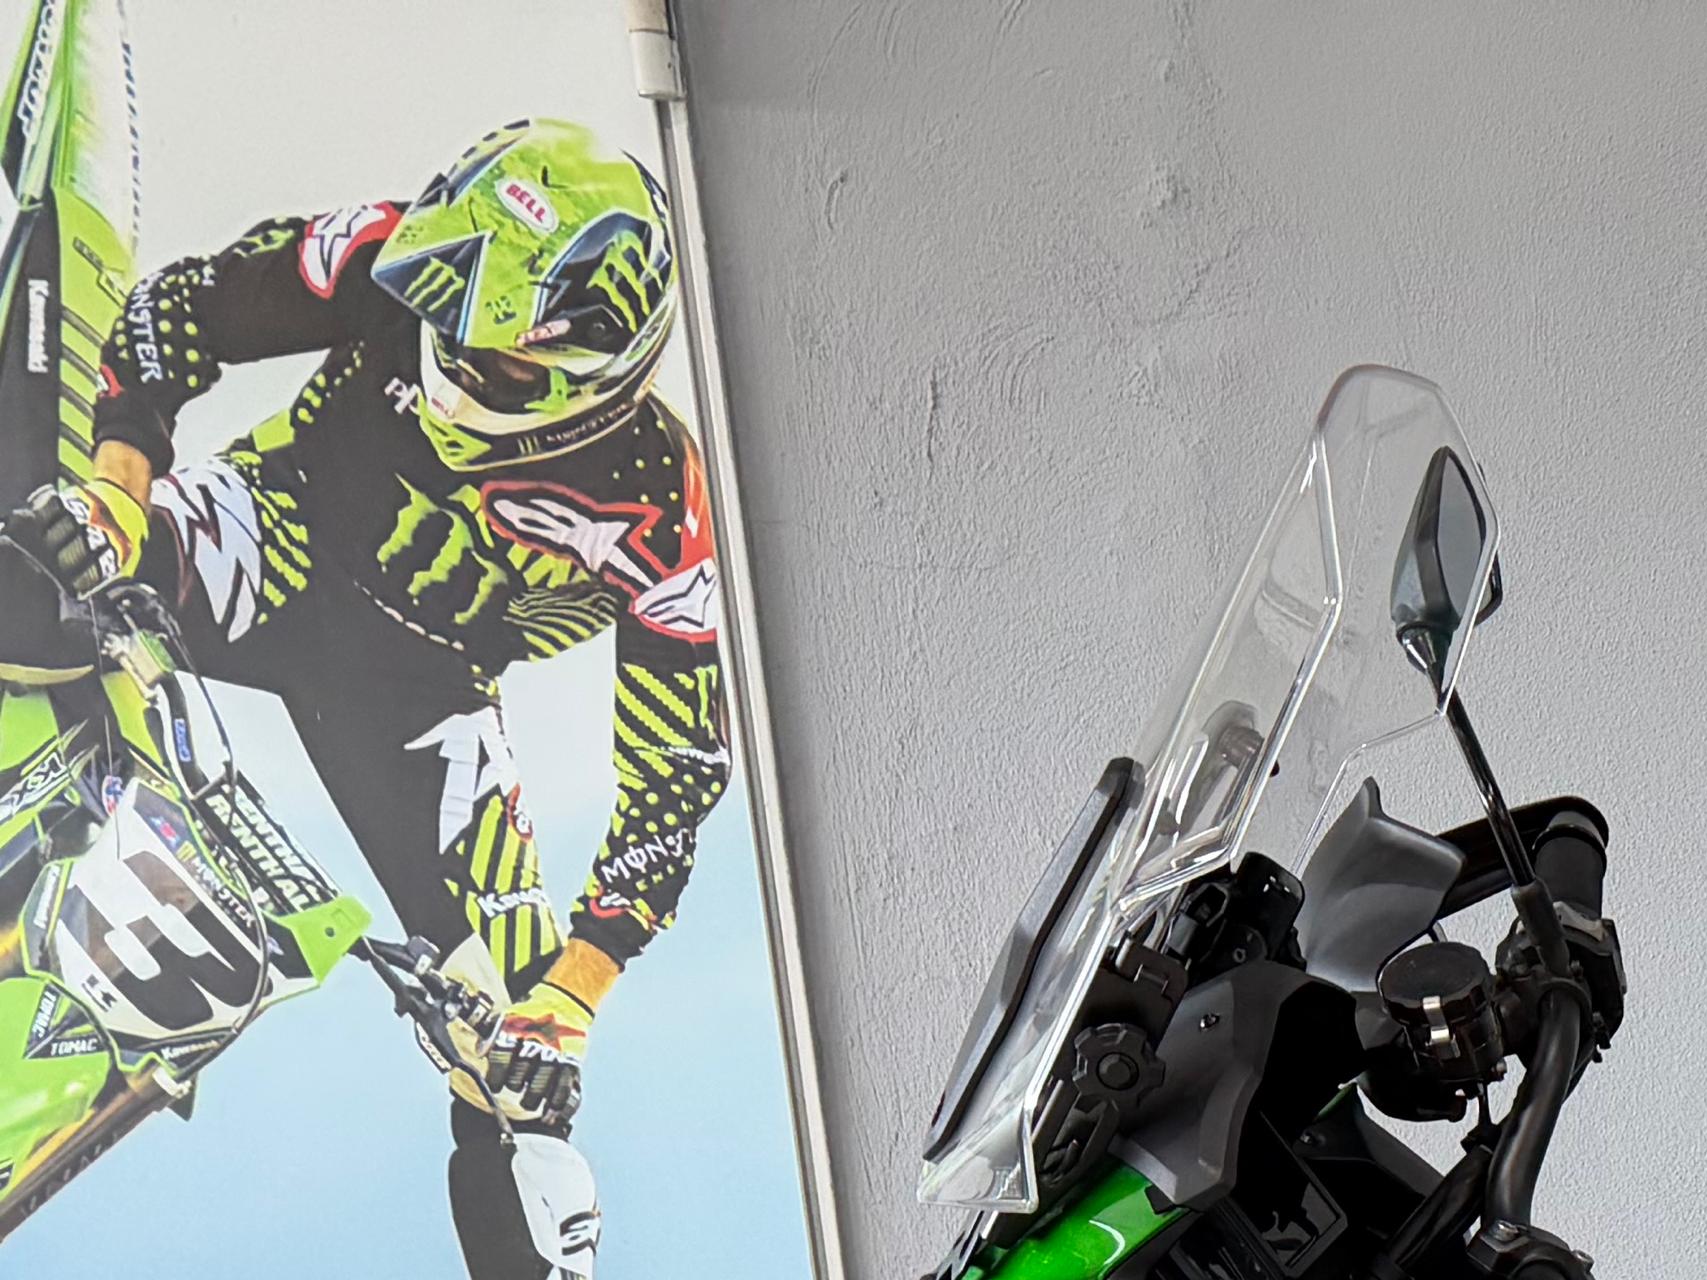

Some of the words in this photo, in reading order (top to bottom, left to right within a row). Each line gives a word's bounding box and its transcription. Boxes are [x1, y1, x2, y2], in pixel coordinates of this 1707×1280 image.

[505, 182, 550, 225] BELL
[32, 990, 57, 1038] TOMAC
[50, 1037, 99, 1057] TOMAC
